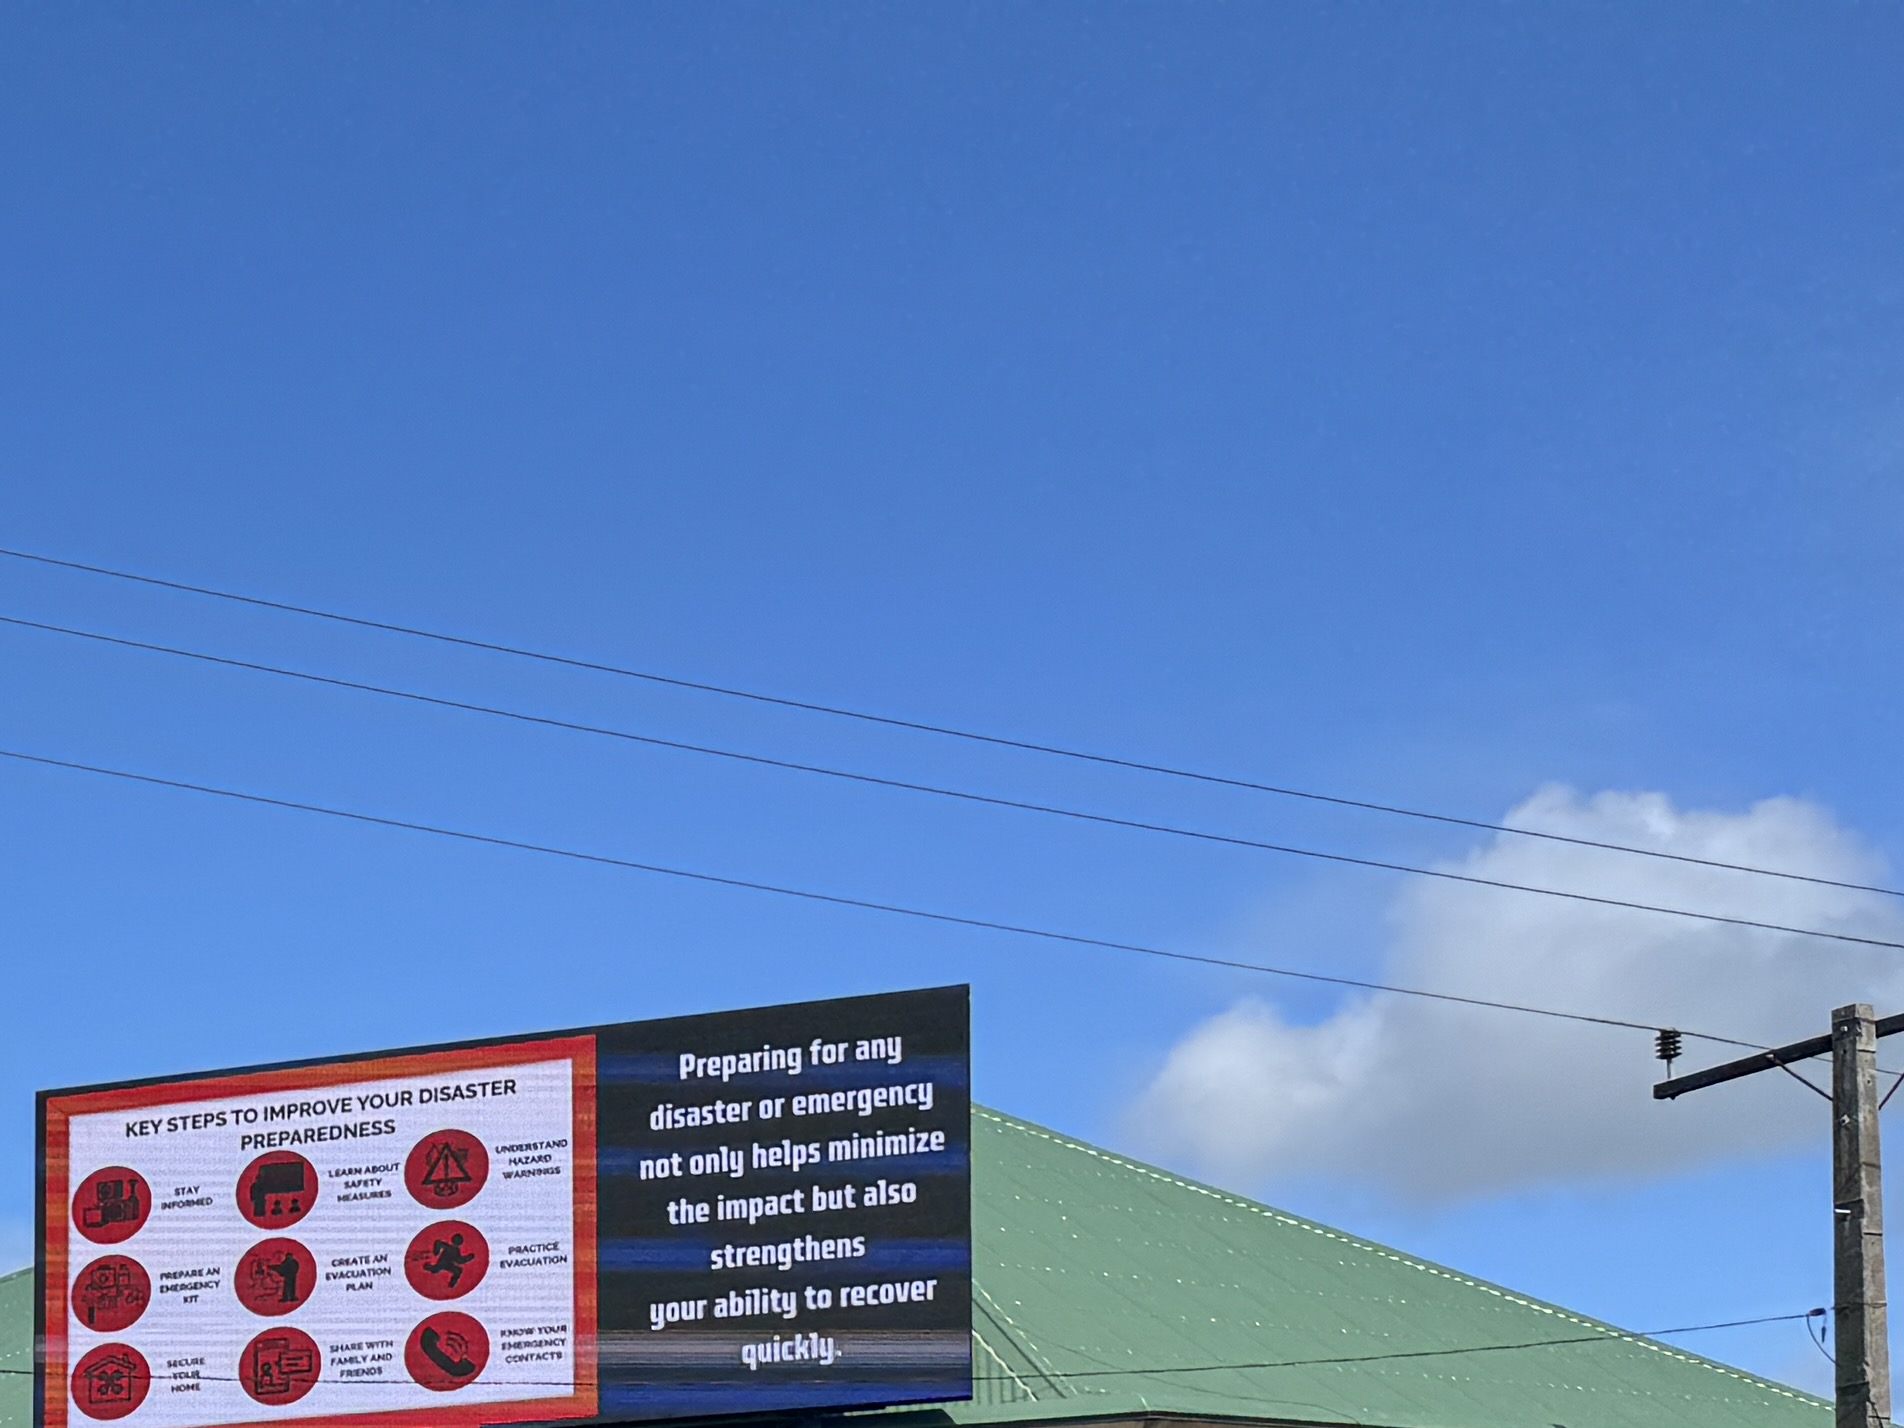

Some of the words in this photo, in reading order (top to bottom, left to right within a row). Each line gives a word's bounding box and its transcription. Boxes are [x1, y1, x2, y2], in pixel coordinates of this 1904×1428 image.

[679, 1044, 802, 1082] Preparing
[809, 1038, 849, 1066] for
[855, 1036, 902, 1064] any
[125, 1119, 163, 1138] KEY
[167, 1111, 227, 1133] STEPS
[231, 1108, 258, 1126] TO
[263, 1096, 352, 1122] IMPROVE
[357, 1090, 413, 1112] YOUR
[418, 1079, 517, 1105] DISASTER
[650, 1101, 752, 1131] disaster
[759, 1097, 785, 1120] or
[792, 1082, 933, 1116] emergency
[241, 1118, 396, 1150] PREPAREDNESS
[495, 1138, 568, 1154] UNDERSTAND
[639, 1152, 682, 1180] not
[689, 1146, 743, 1178] only
[752, 1139, 820, 1172] helps
[828, 1127, 945, 1162] minimize
[508, 1153, 552, 1167] HAZARD
[328, 1165, 362, 1178] LEARN
[364, 1162, 400, 1175] ABOUT
[174, 1185, 200, 1197] STAY
[344, 1177, 382, 1190] SAFETY
[160, 1197, 213, 1211] INFORMED
[667, 1198, 710, 1225] the
[717, 1188, 805, 1225] impact
[812, 1184, 856, 1212] but
[863, 1179, 917, 1207] also
[508, 1241, 560, 1255] PRACTICE
[710, 1234, 866, 1270] strengthens
[331, 1255, 370, 1268] CREATE
[372, 1253, 388, 1264] AN
[500, 1254, 567, 1269] EVACUATION
[160, 1268, 204, 1281] PREPARE
[206, 1266, 221, 1277] AN
[325, 1266, 391, 1281] EVACUATION
[346, 1281, 373, 1292] PLAN
[650, 1298, 707, 1331] your
[713, 1288, 797, 1319] ability
[804, 1285, 832, 1310] to
[841, 1279, 938, 1308] recover
[370, 1352, 393, 1363] AND
[742, 1331, 842, 1371] quickly.
